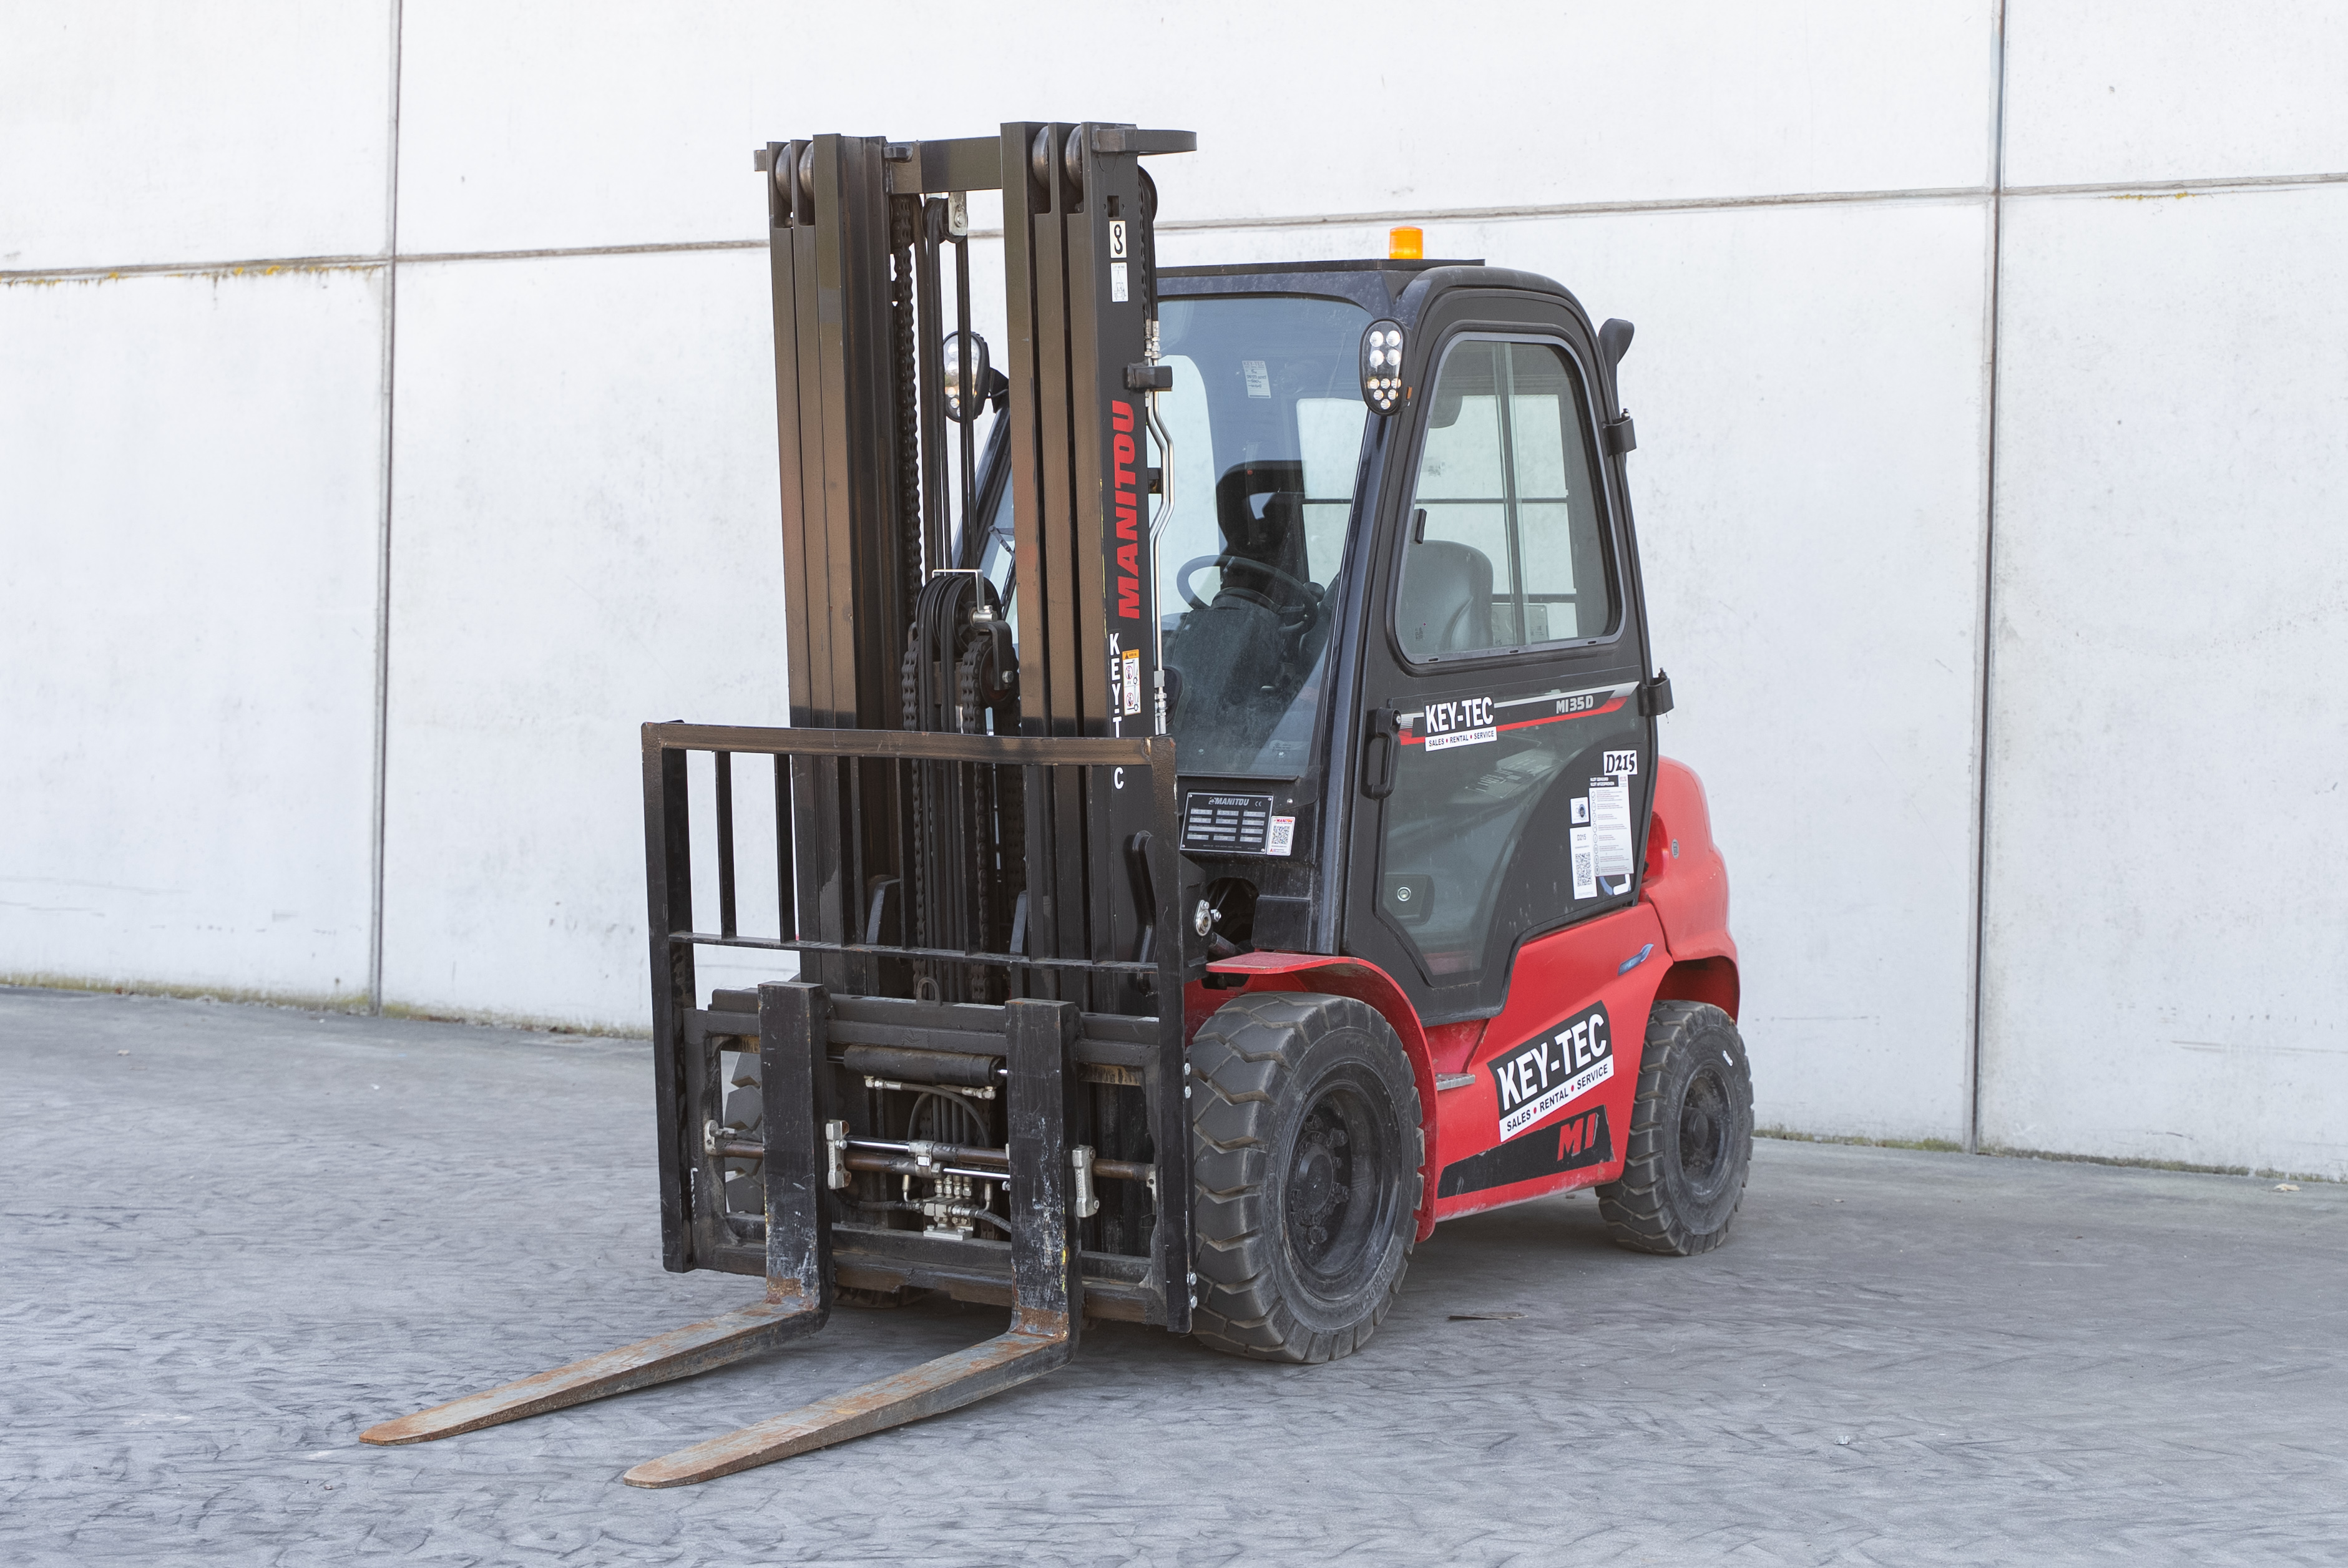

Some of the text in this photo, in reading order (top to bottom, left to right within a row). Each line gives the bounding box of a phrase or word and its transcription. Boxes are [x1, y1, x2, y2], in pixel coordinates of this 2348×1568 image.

[1112, 399, 1140, 619] MANITOU
[1109, 632, 1125, 789] KEY-TC
[1425, 696, 1495, 733] KEY-TEC
[1429, 730, 1494, 747] SALES RENTAL SERVICE
[1605, 752, 1635, 774] D215
[1215, 797, 1250, 806] MANITOU
[1497, 1013, 1607, 1111] KEY-TEC
[1507, 1063, 1608, 1132] SALES RENTAL SERVICE
[1557, 1113, 1600, 1162] MI
